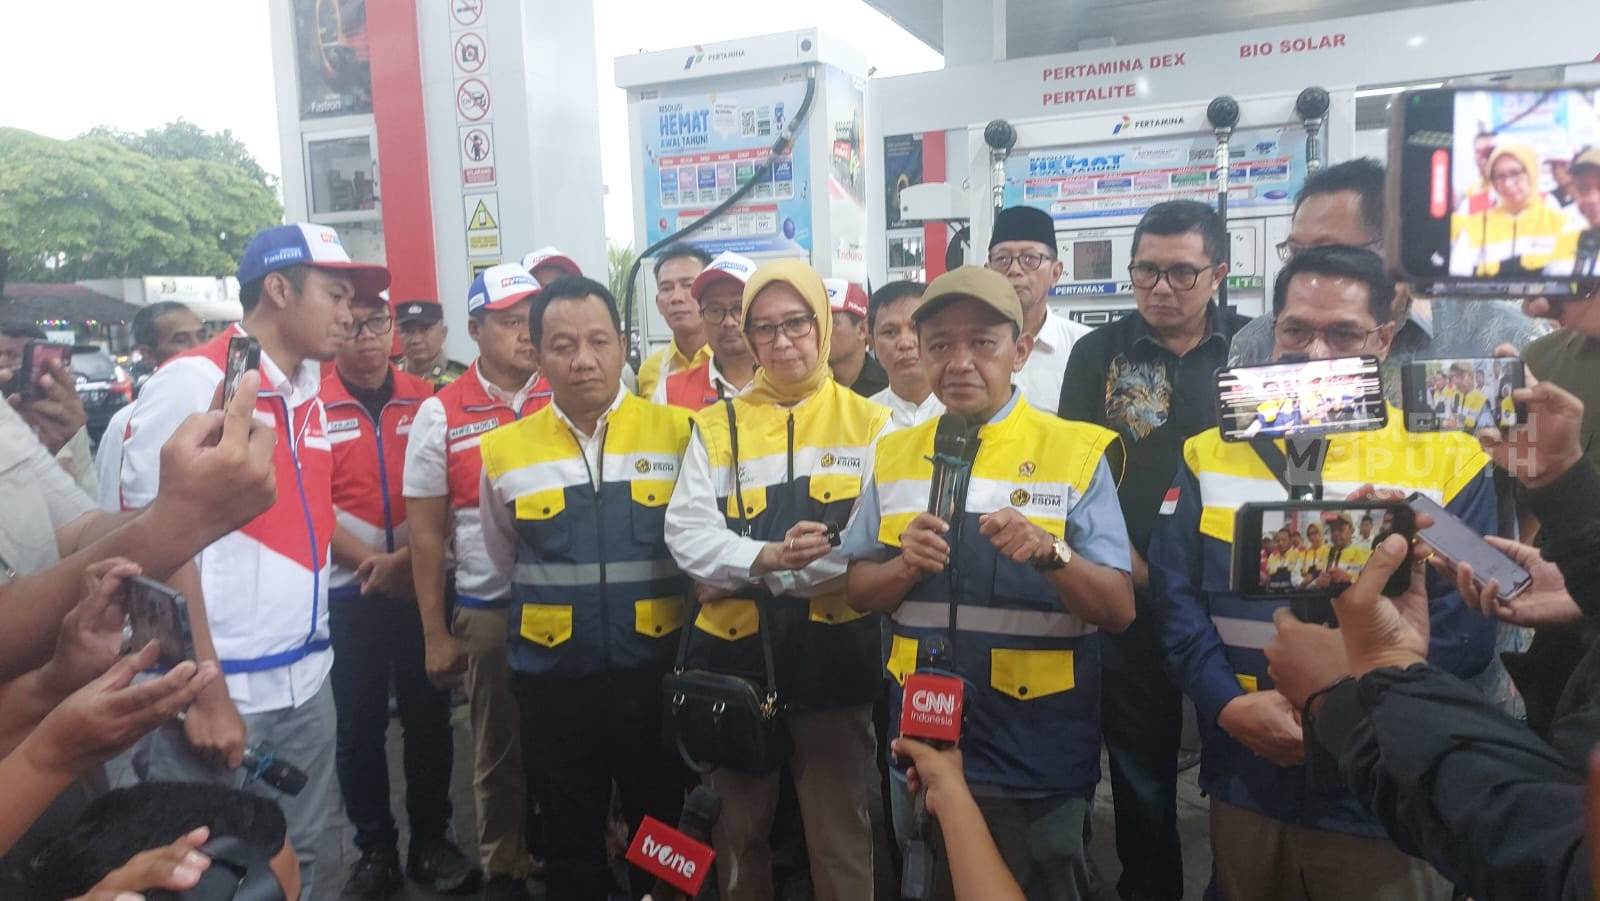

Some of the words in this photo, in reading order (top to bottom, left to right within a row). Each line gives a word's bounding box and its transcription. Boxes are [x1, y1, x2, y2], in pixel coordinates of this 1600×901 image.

[1239, 41, 1273, 58] BIO
[1280, 33, 1346, 54] SOLAR
[708, 50, 745, 61] PERTAMINA
[1042, 58, 1143, 81] PERTAMINA
[1149, 52, 1185, 69] DEX
[1042, 84, 1136, 105] PERTALITE
[659, 109, 709, 136] HEMAT
[1135, 116, 1185, 129] PERTAMINA
[660, 138, 681, 148] AWAL
[1030, 154, 1125, 172] HEMAT
[1055, 284, 1105, 296] PERTAMAX
[1226, 277, 1263, 288] LITE
[1032, 497, 1061, 507] ESDM
[912, 690, 955, 715] CNN
[911, 710, 953, 727] Indonesia
[641, 834, 696, 878] tvOne
